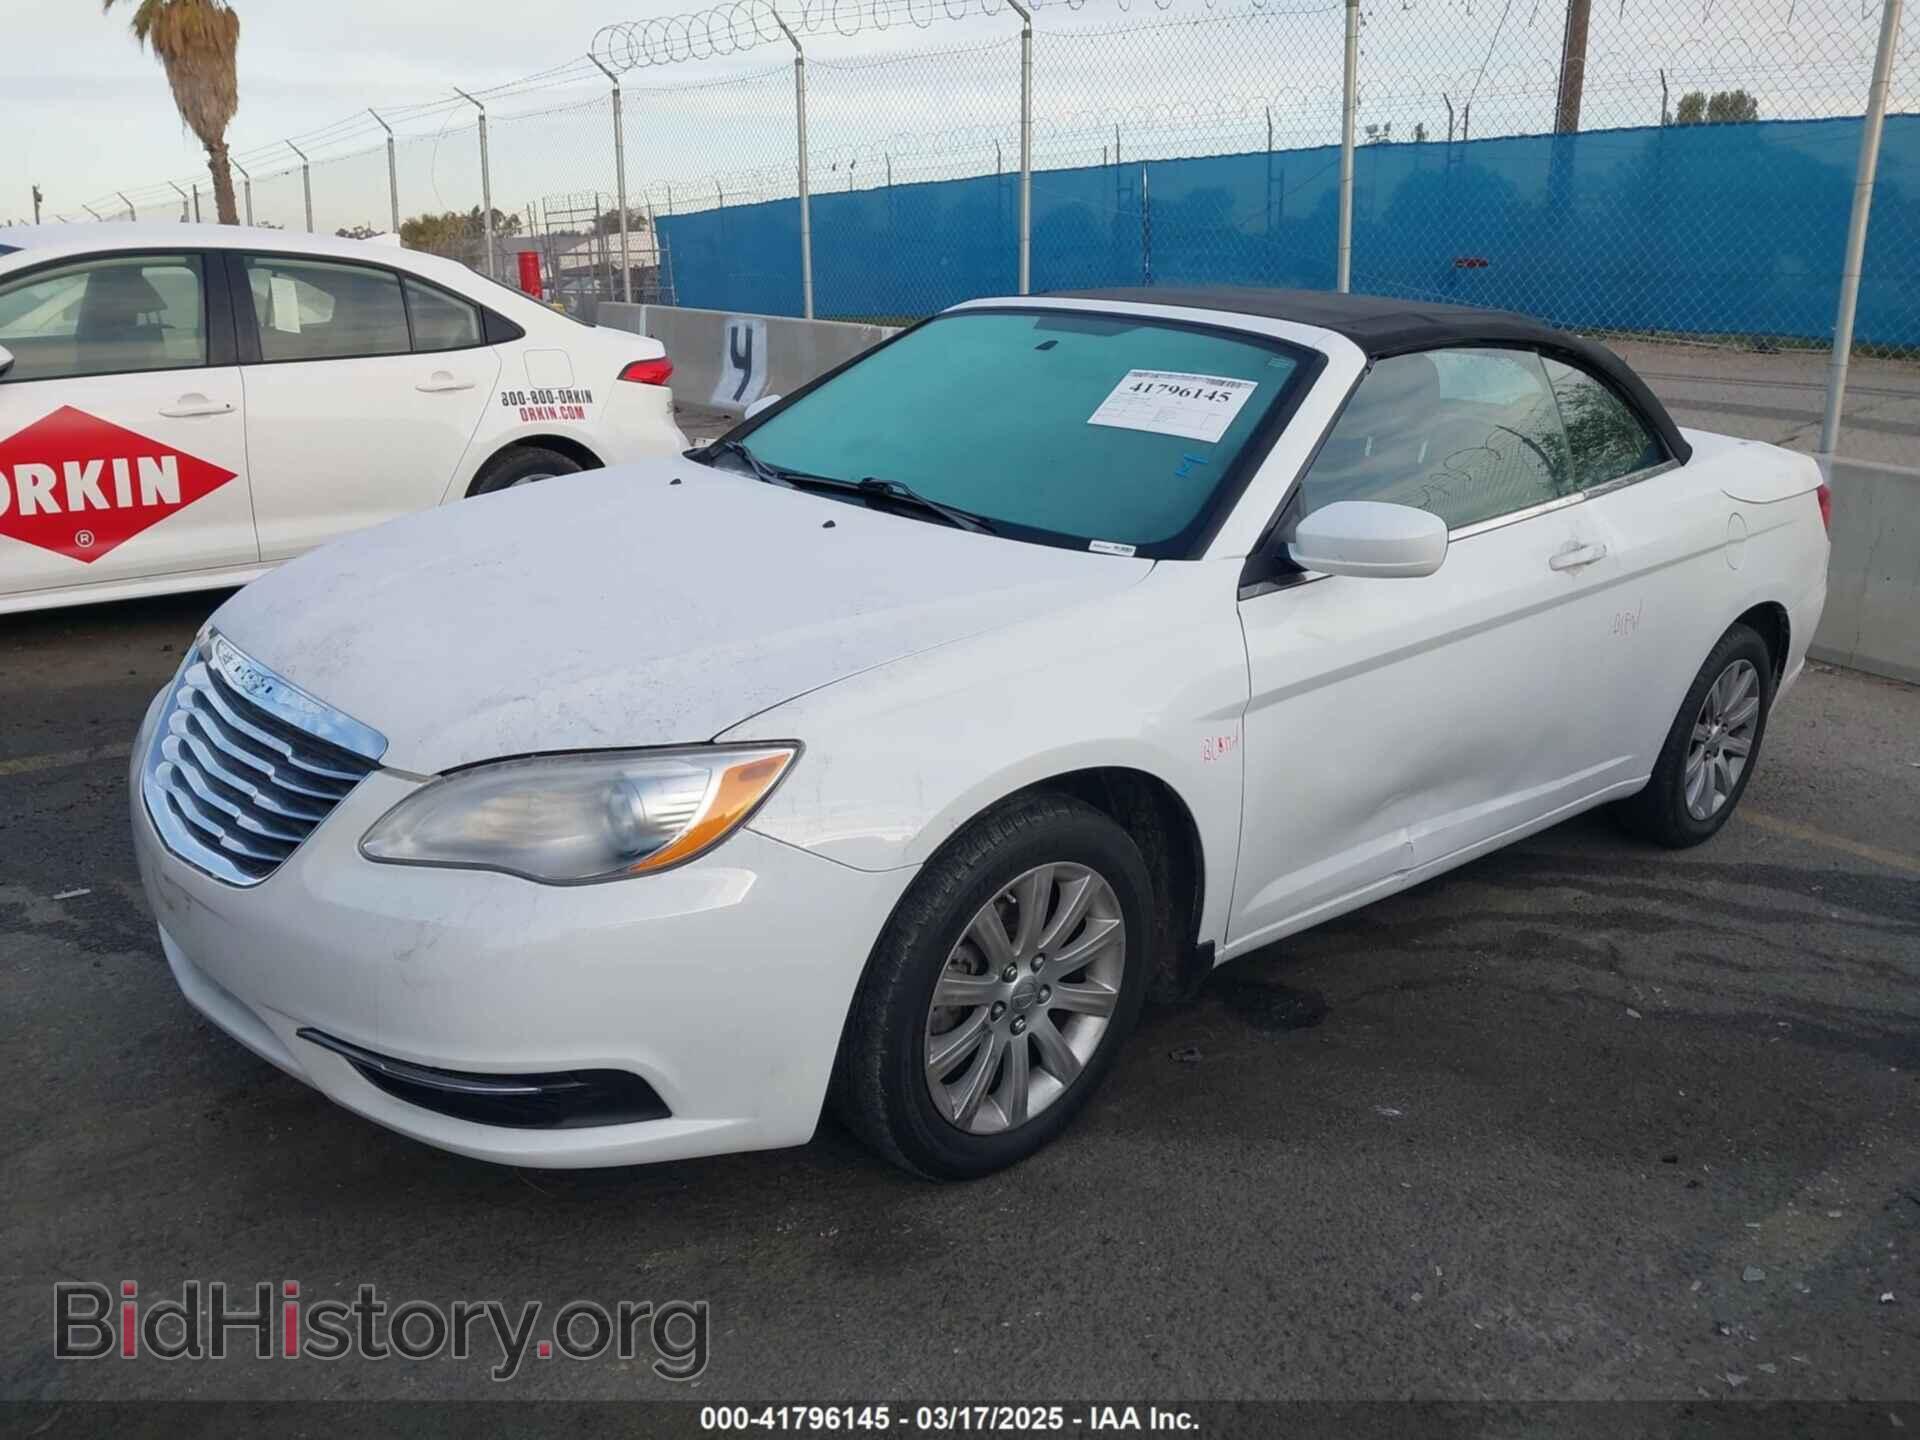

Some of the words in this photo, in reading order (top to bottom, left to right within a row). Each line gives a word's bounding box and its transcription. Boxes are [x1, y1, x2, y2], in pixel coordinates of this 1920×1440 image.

[501, 390, 593, 406] 800-800-ORKIN
[1129, 381, 1232, 402] 41796145
[519, 405, 586, 422] ORKIN.COM
[0, 455, 181, 517] RKIN
